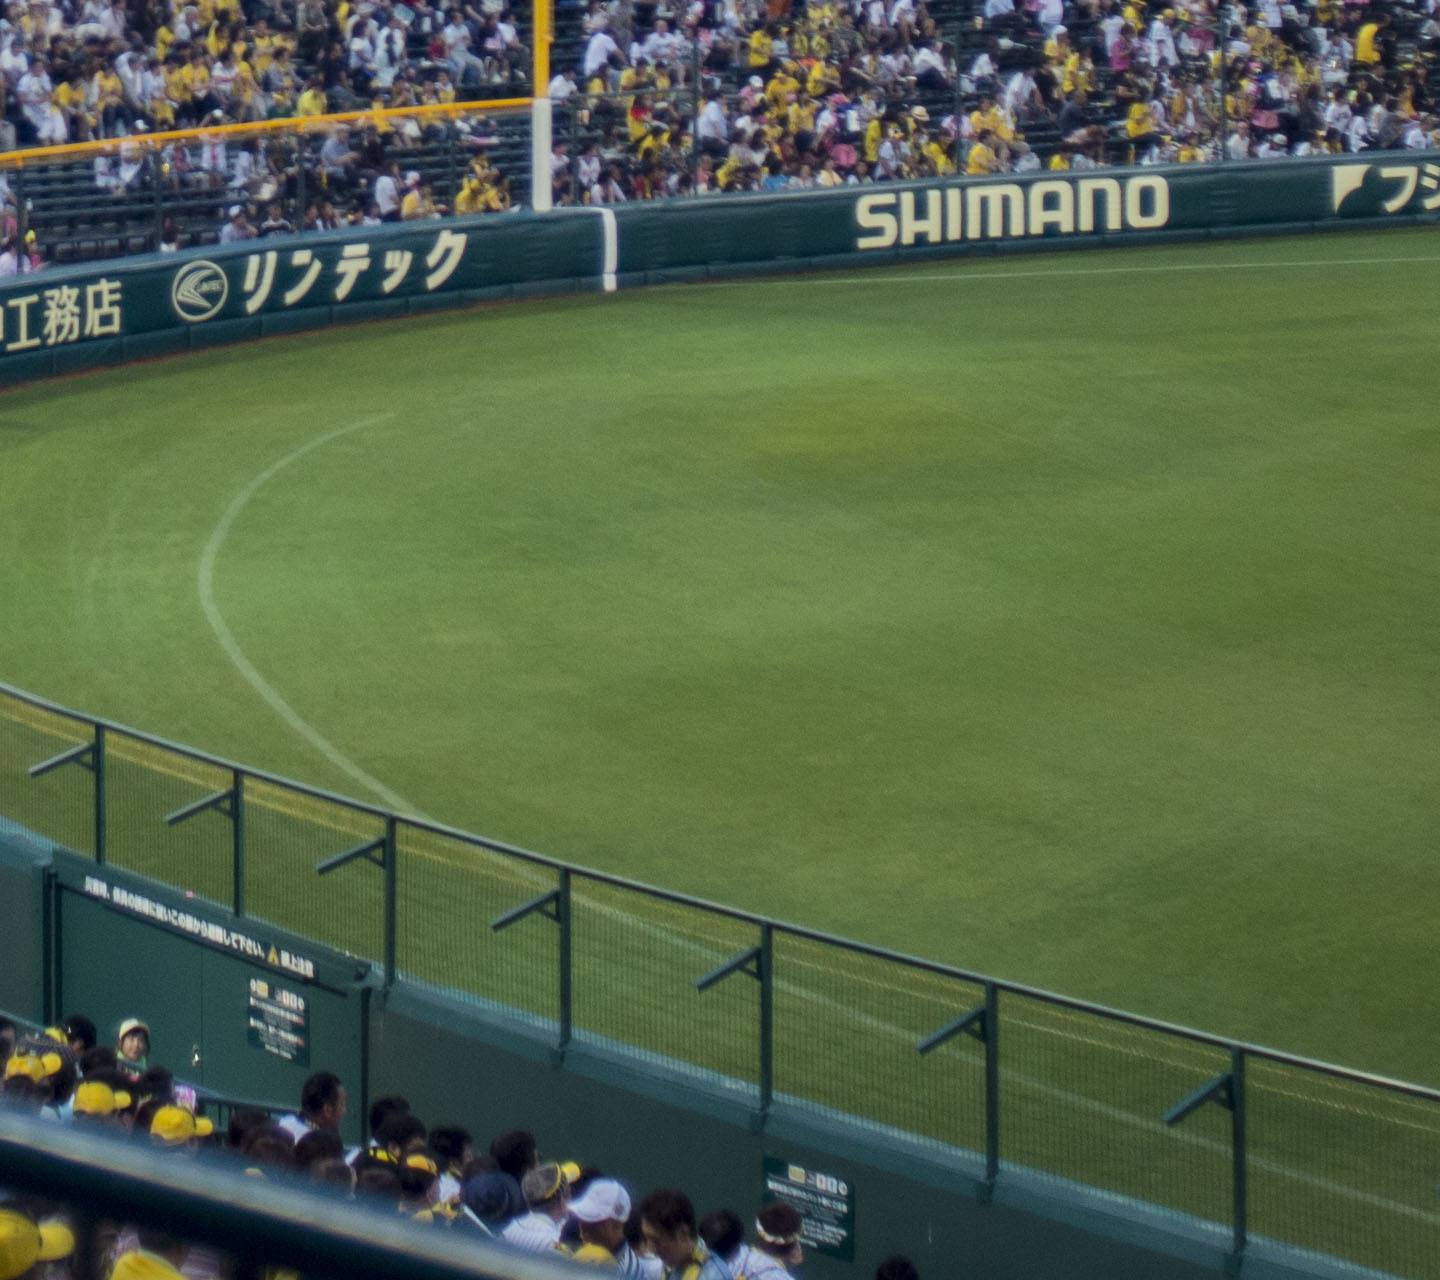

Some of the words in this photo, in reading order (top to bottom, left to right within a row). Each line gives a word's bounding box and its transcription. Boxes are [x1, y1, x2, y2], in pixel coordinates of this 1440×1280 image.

[855, 173, 1170, 251] SHIMANO
[241, 229, 468, 316] リンテック
